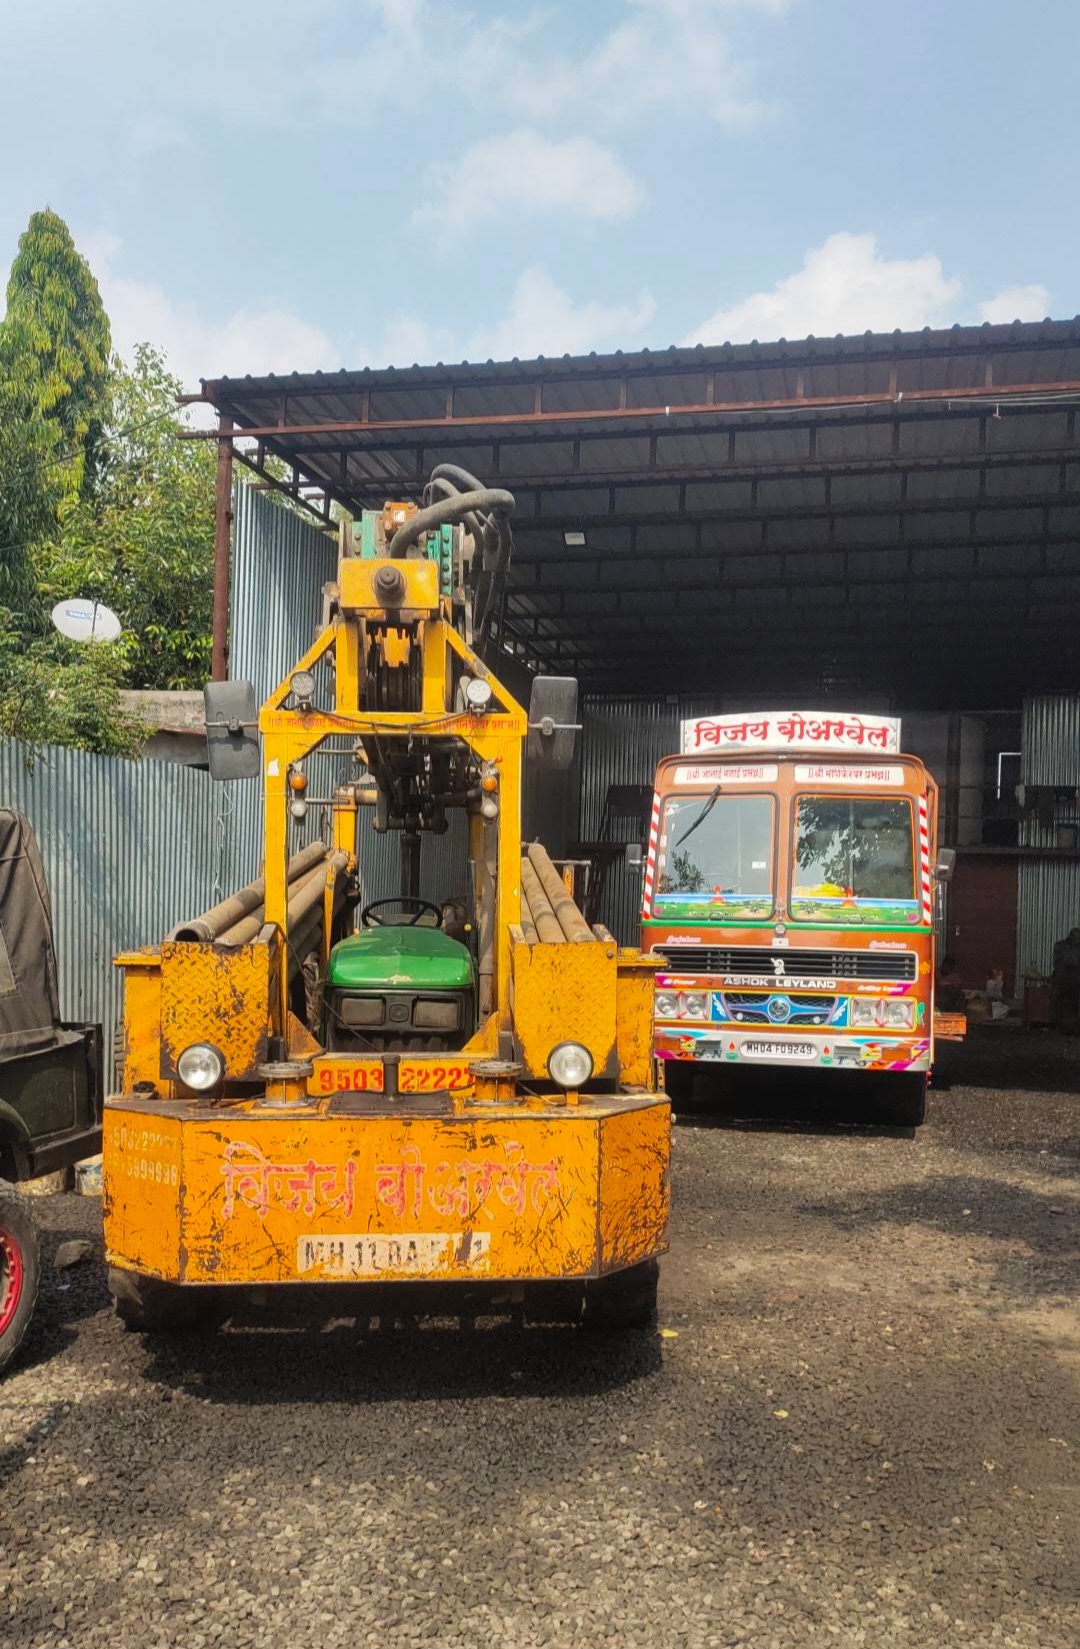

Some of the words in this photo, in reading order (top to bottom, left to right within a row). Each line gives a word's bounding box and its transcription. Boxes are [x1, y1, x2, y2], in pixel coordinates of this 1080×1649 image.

[694, 720, 770, 748] विजय
[777, 713, 889, 748] बोअरवेल
[723, 977, 769, 987] ASHOK
[775, 979, 837, 989] LEYLAND
[746, 1043, 772, 1053] MH04
[320, 1068, 383, 1092] 9503
[220, 1141, 358, 1220] विजय
